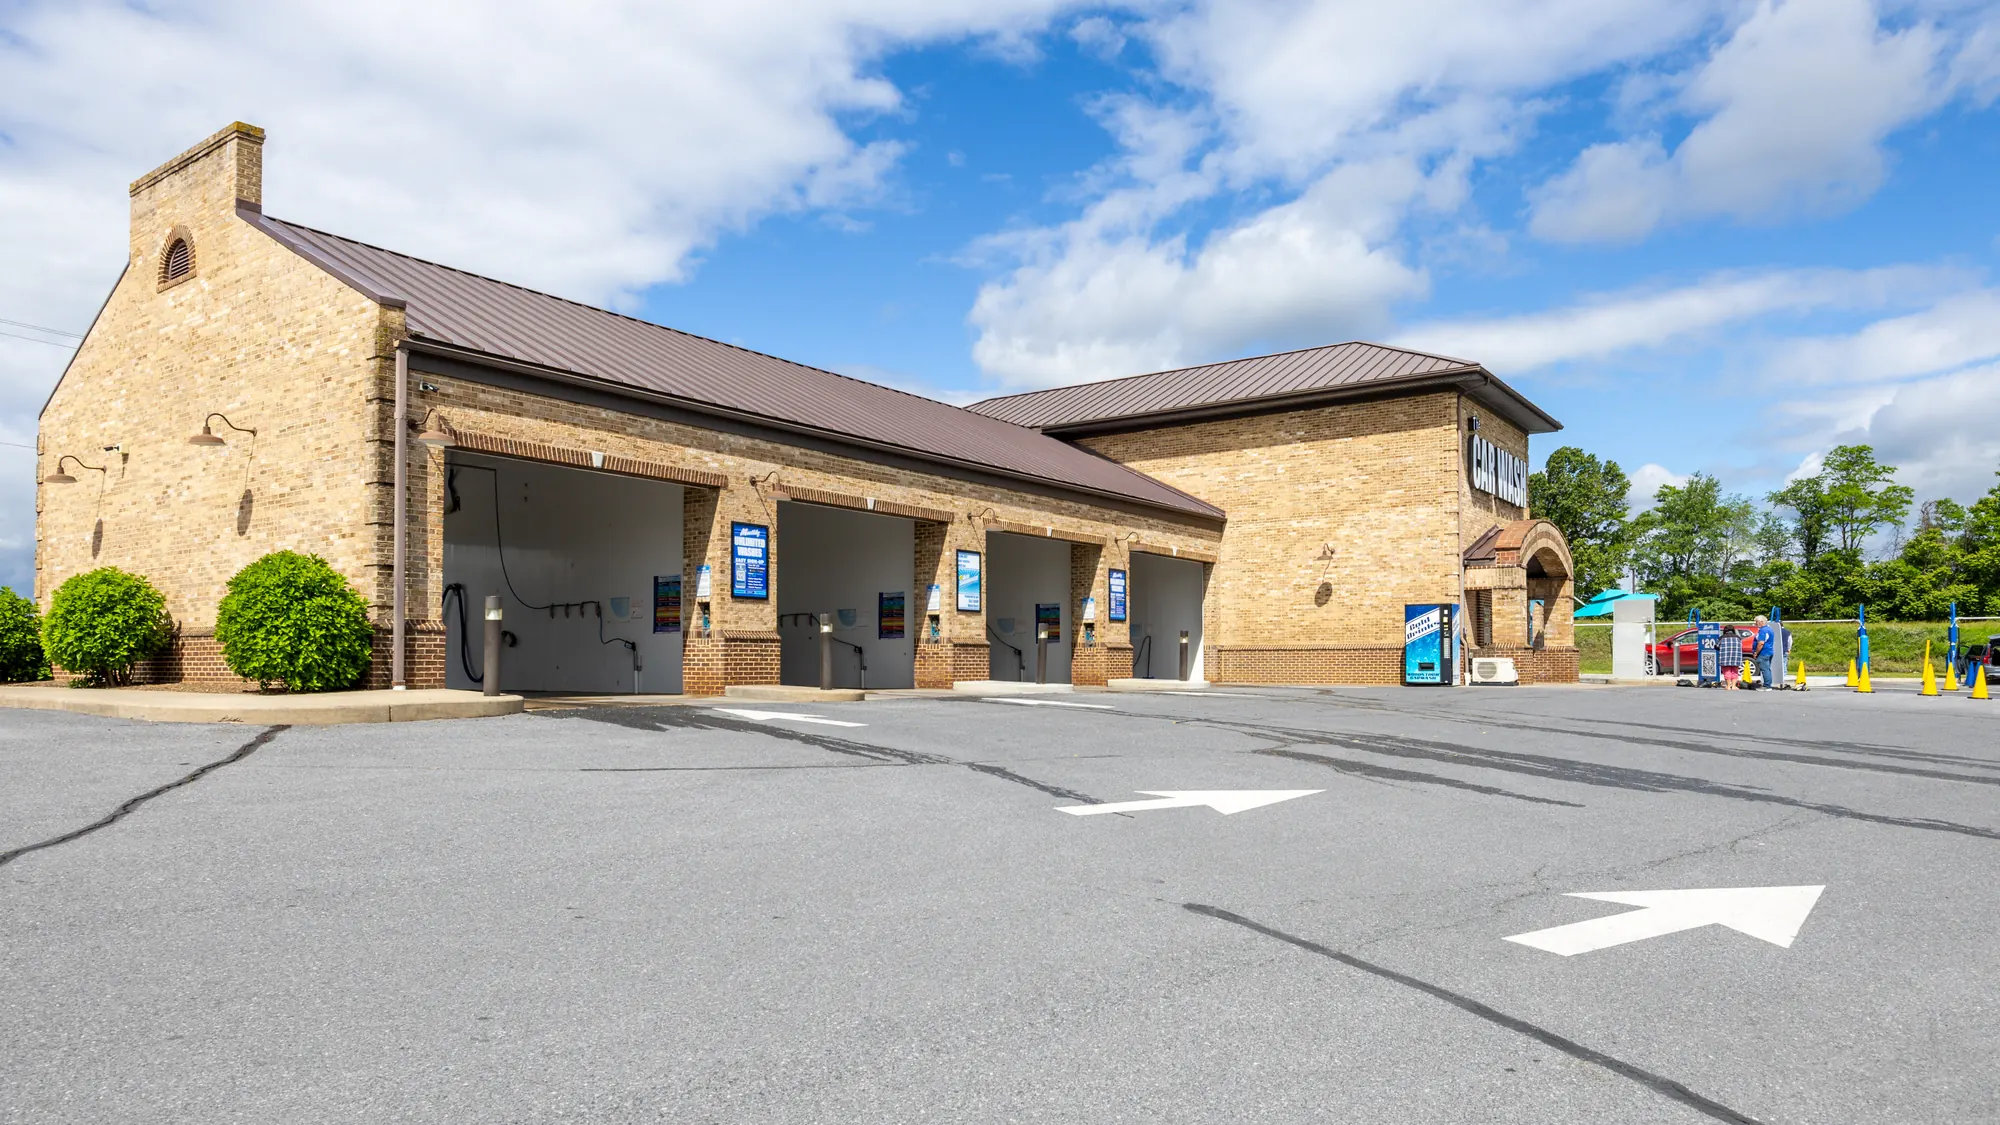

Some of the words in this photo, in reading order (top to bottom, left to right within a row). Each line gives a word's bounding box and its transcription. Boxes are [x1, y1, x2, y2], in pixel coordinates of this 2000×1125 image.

[1473, 434, 1495, 495] CAR
[1497, 447, 1527, 508] WASH
[734, 536, 765, 548] UNLIMITED
[737, 547, 762, 557] WASHES
[1409, 617, 1430, 630] Cold
